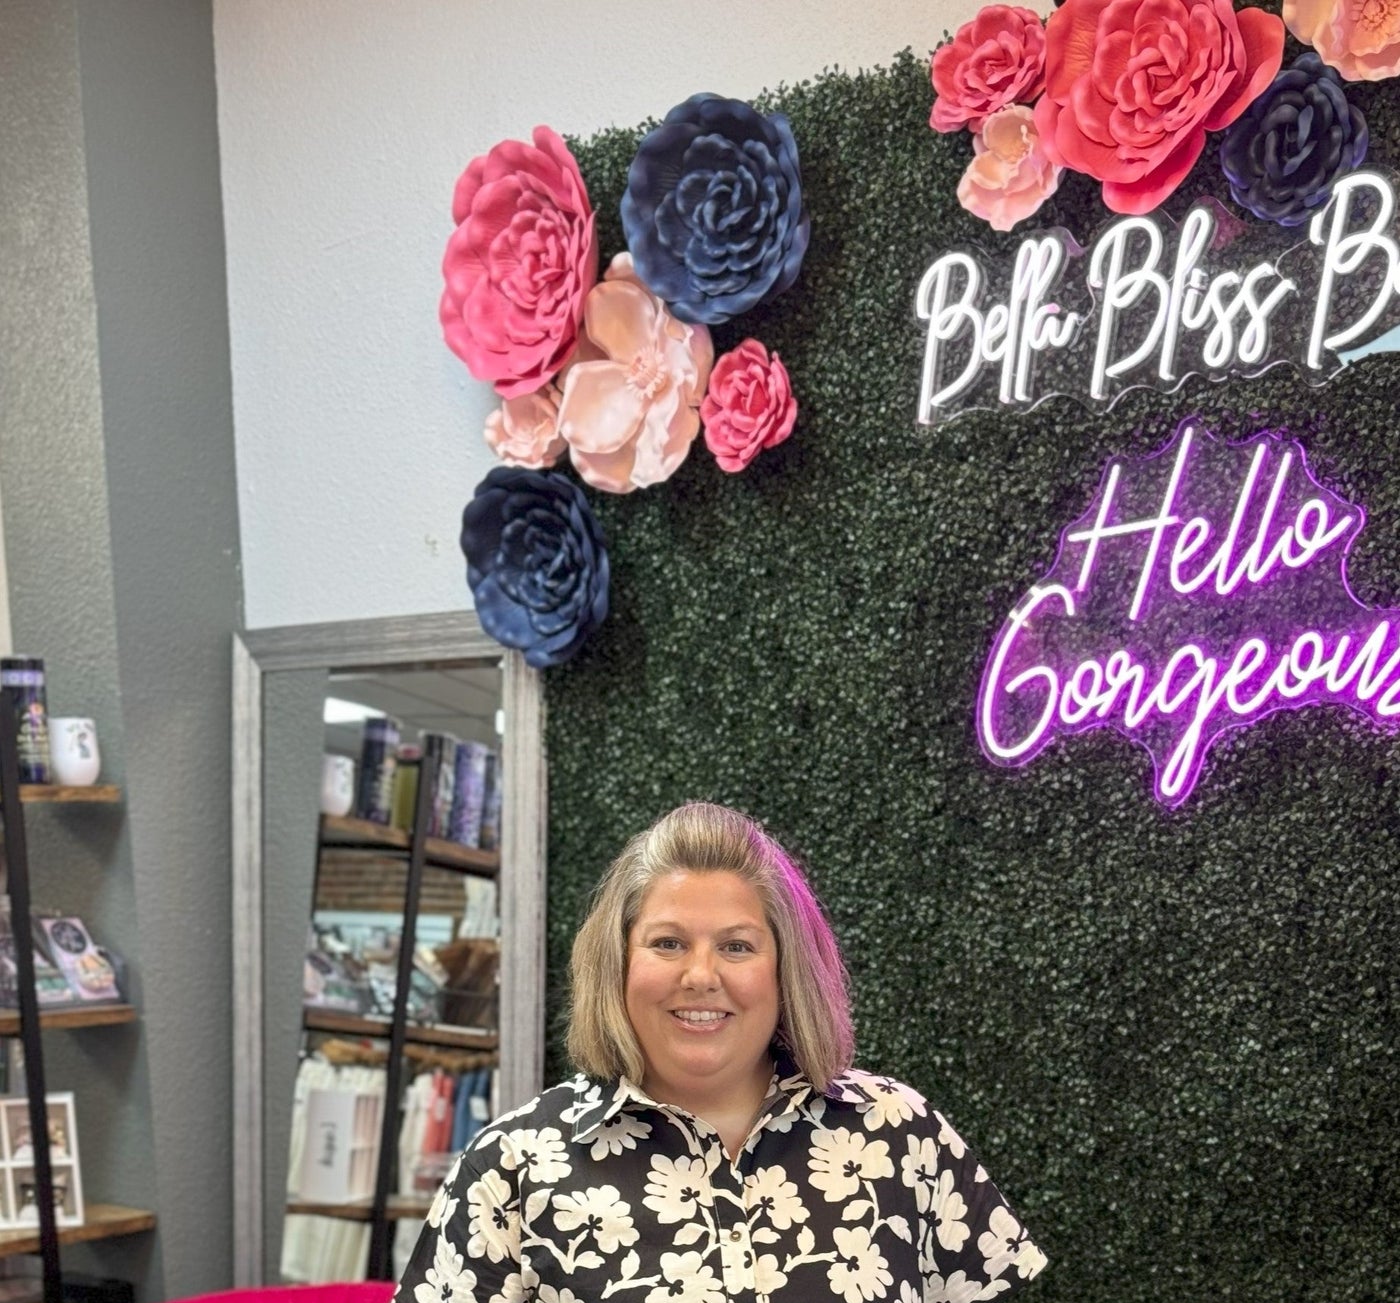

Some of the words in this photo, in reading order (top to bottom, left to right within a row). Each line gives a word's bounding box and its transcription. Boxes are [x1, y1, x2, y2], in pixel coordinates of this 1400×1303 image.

[916, 237, 1078, 424] Bella
[1090, 209, 1295, 399] Bliss
[1308, 173, 1400, 369] B
[1068, 427, 1351, 620] Hello
